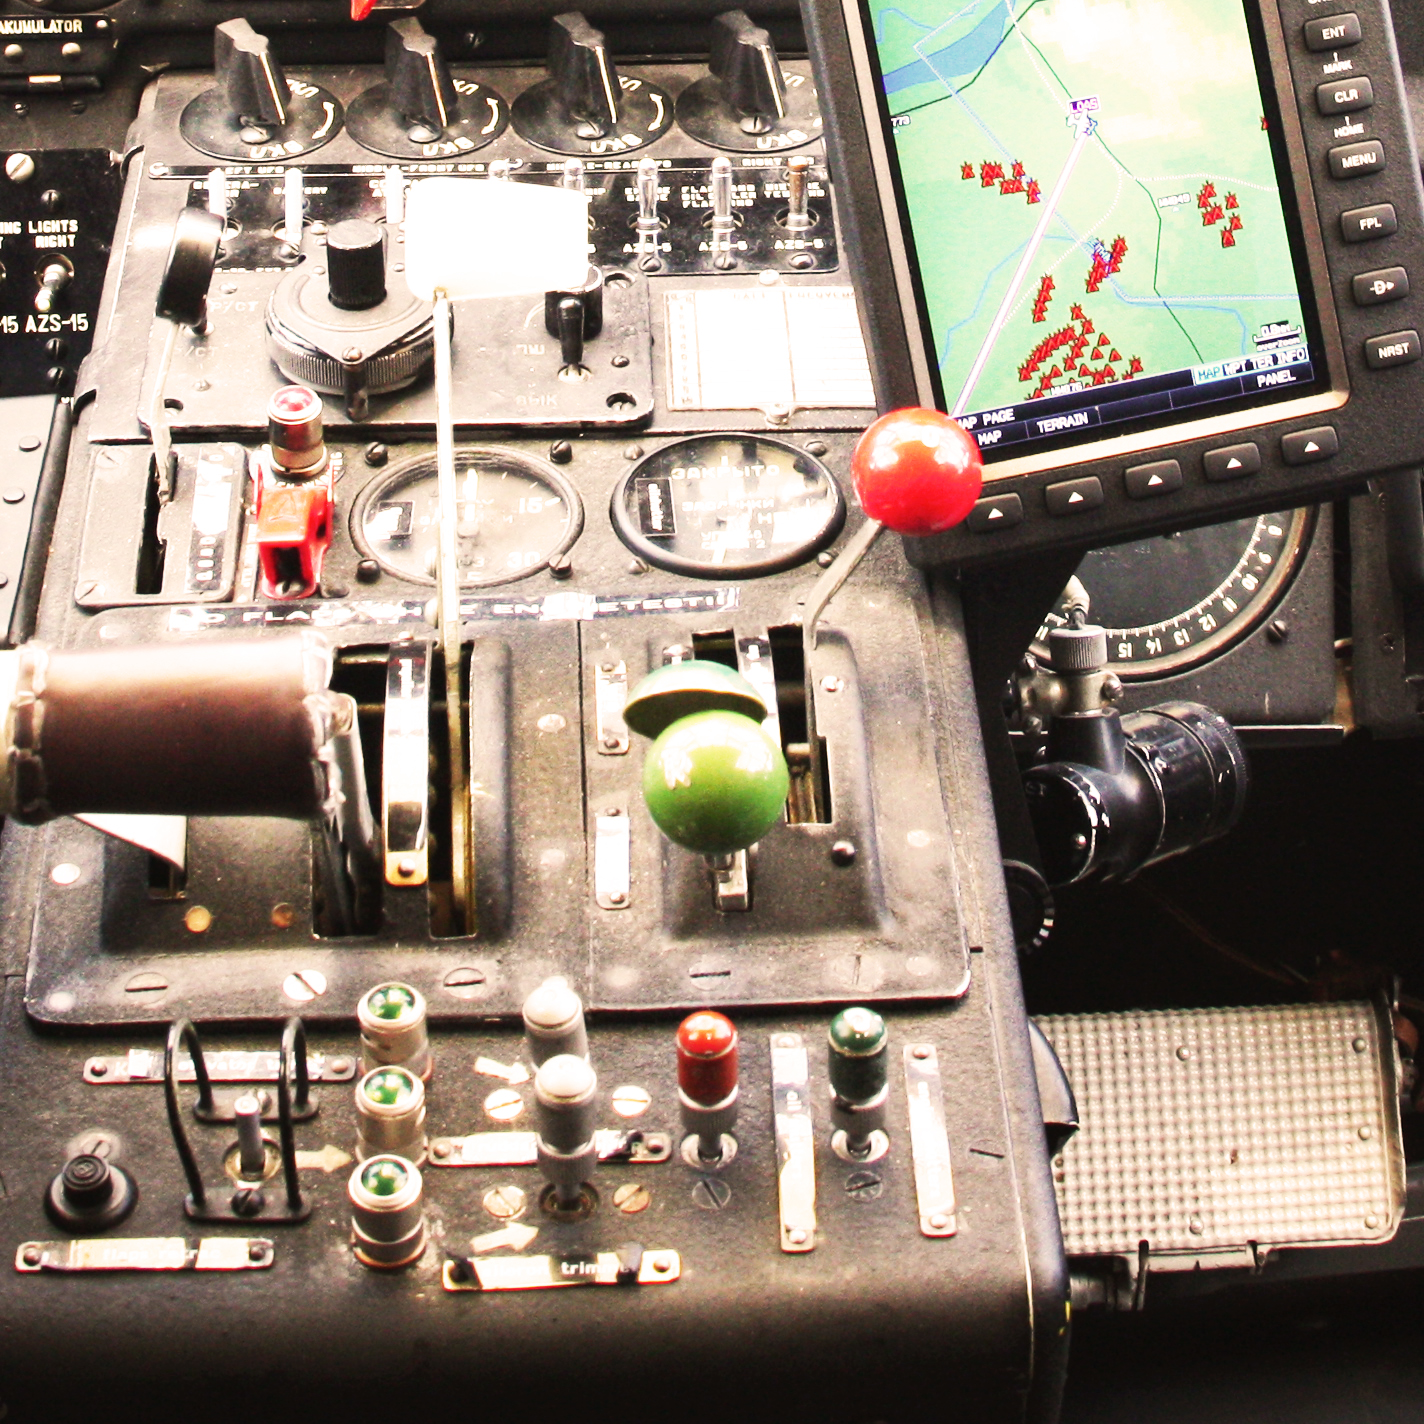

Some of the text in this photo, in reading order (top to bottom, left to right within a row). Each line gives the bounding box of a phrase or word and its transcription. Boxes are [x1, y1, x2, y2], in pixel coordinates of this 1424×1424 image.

[1322, 26, 1346, 40] ENT
[1323, 60, 1353, 74] MARK
[1334, 89, 1359, 103] CLR
[1334, 123, 1364, 138] HOME
[1341, 152, 1376, 168] MENU
[28, 219, 78, 234] LIGHTS
[1359, 217, 1382, 231] FPL
[35, 235, 76, 249] RIGHT
[25, 314, 89, 333] AZS-15
[1378, 343, 1410, 358] NRST
[1256, 369, 1296, 388] PANEL
[982, 408, 1015, 426] PAGE
[1037, 412, 1089, 433] TERRAIN
[977, 429, 1002, 446] MAP
